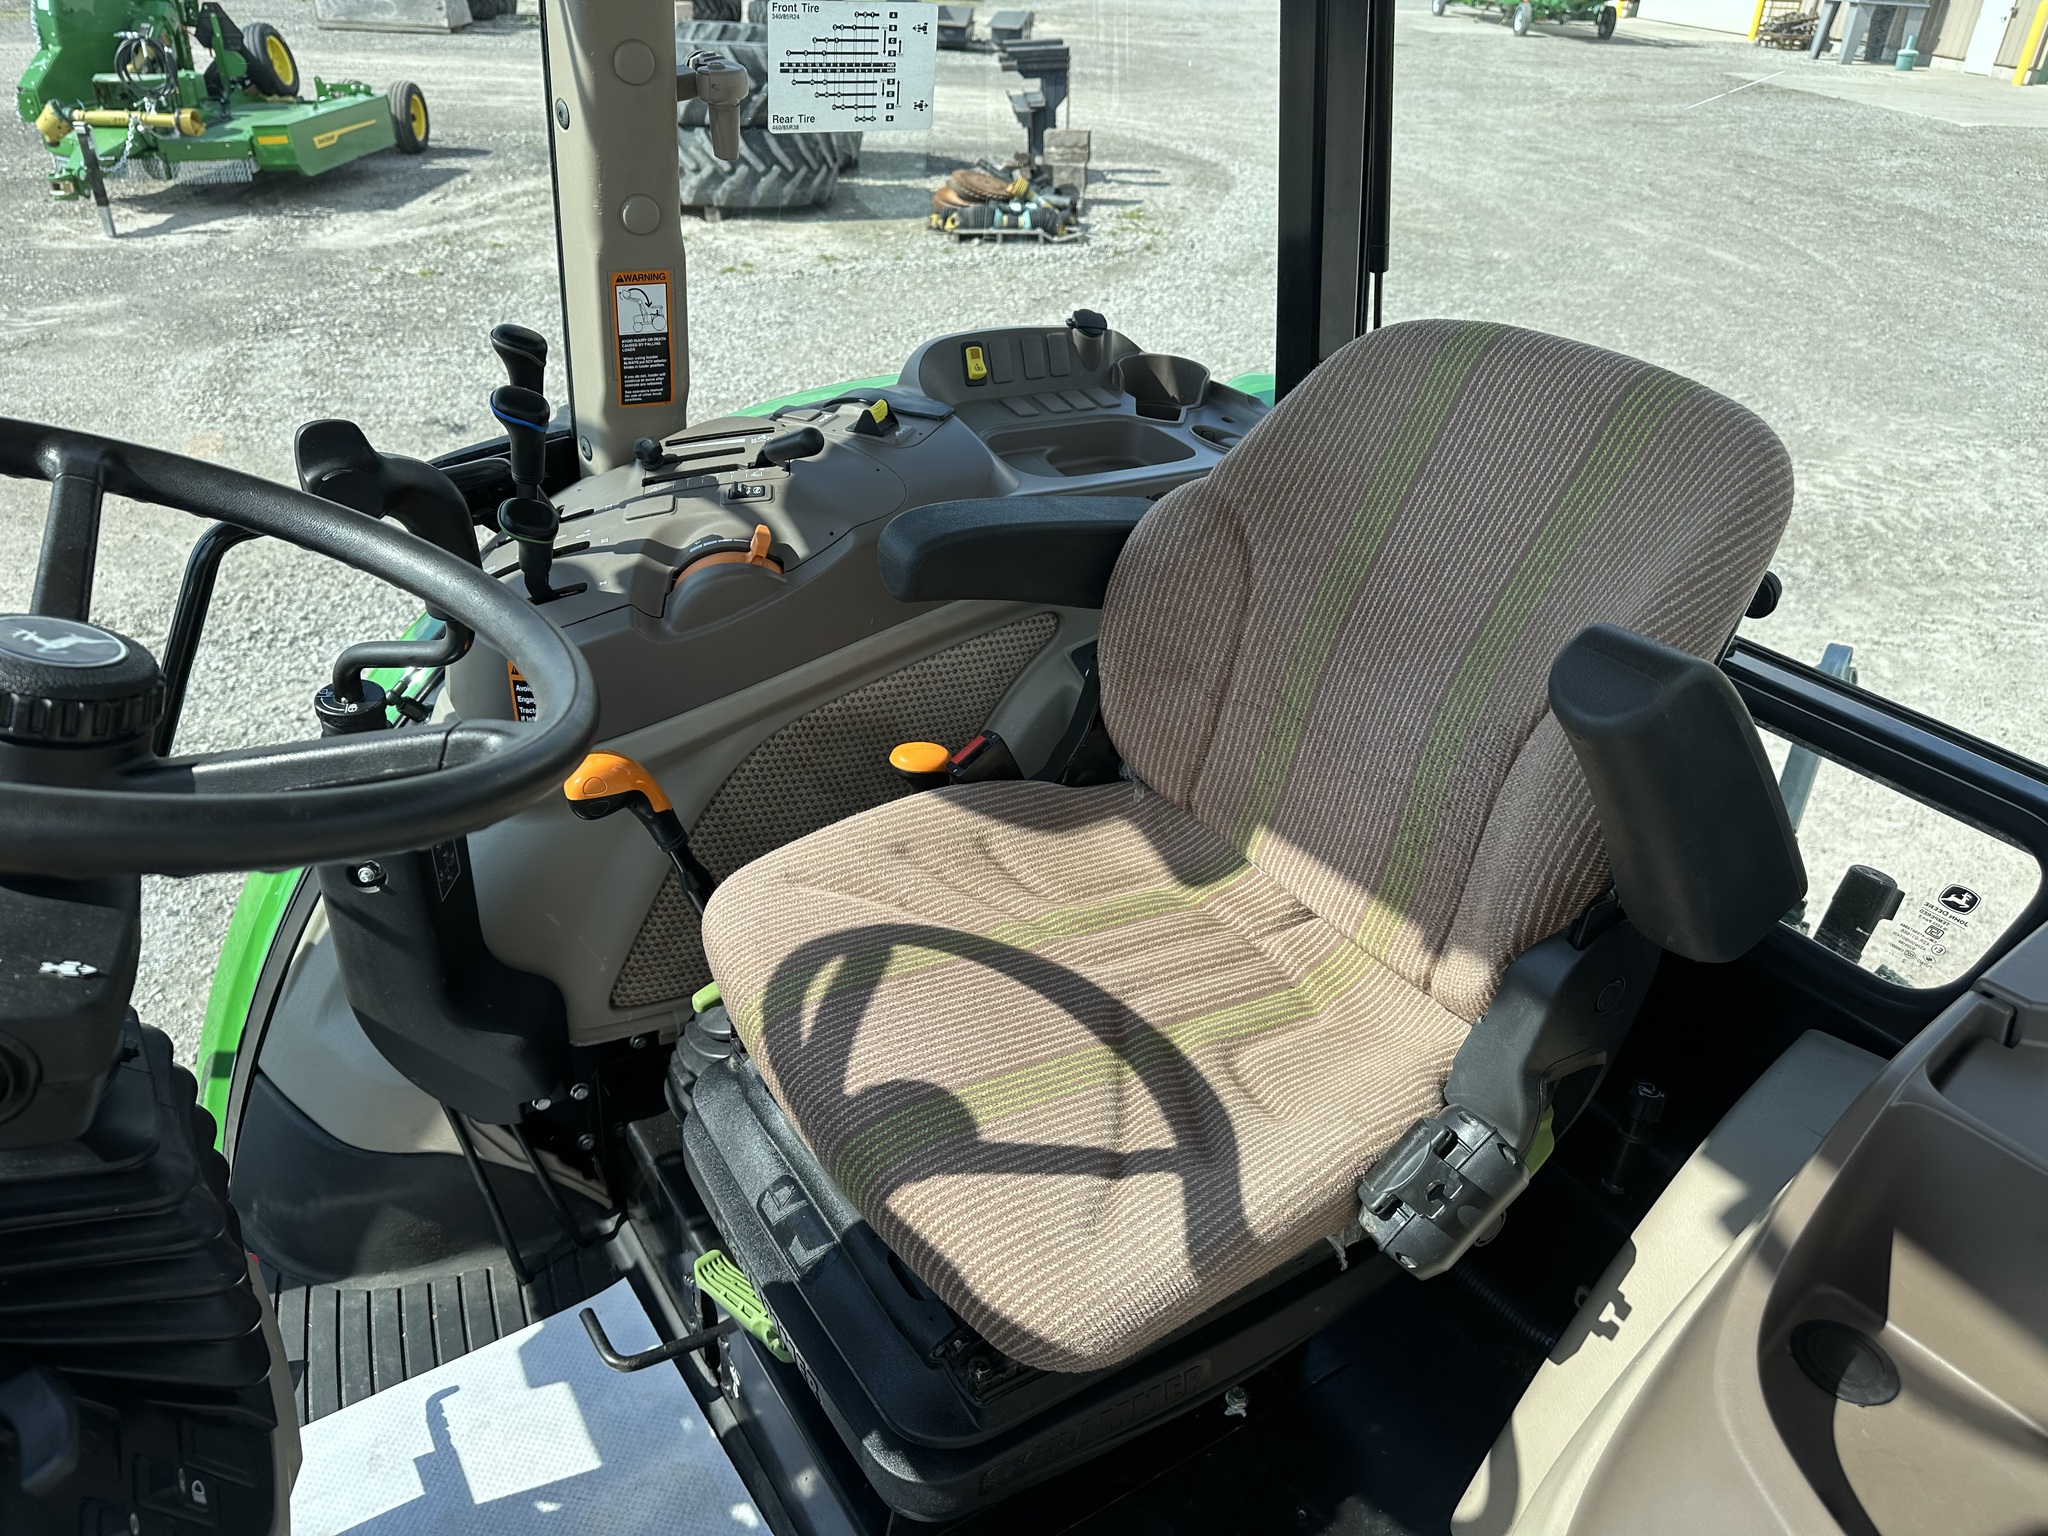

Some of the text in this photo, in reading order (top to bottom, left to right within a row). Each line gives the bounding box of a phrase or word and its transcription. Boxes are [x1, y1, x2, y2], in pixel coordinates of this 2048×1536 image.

[772, 2, 820, 13] Front Tire
[772, 114, 816, 124] Rear Tire
[624, 272, 666, 282] WARNING
[1021, 1364, 1210, 1470] GRAMMER
